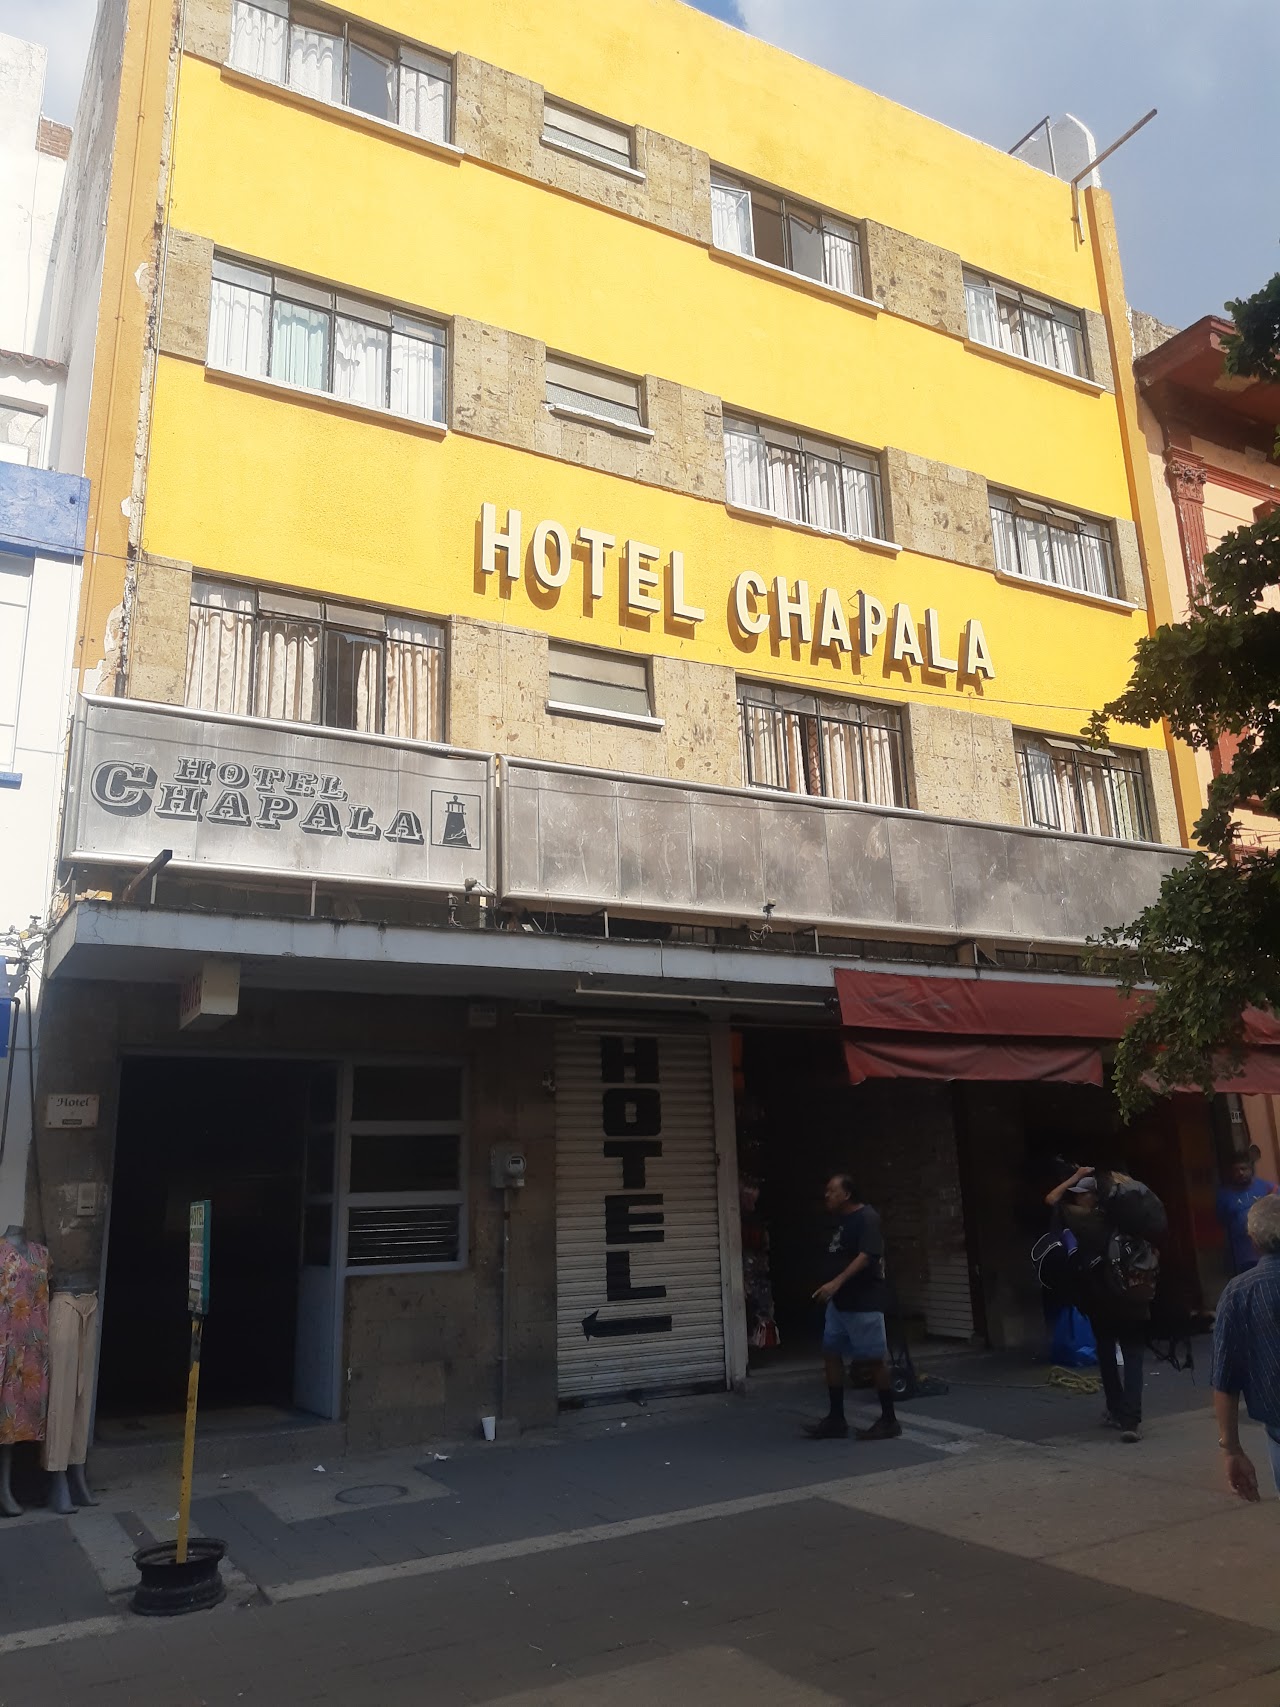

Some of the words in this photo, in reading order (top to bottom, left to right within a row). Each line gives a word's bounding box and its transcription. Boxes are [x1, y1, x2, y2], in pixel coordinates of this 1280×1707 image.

[480, 501, 706, 623] HOTEL
[735, 570, 996, 680] CHAPALA
[89, 760, 425, 846] CHAPALA
[175, 755, 348, 802] HOTEL
[56, 1097, 90, 1107] Hotel
[601, 1036, 667, 1301] HOTEL
